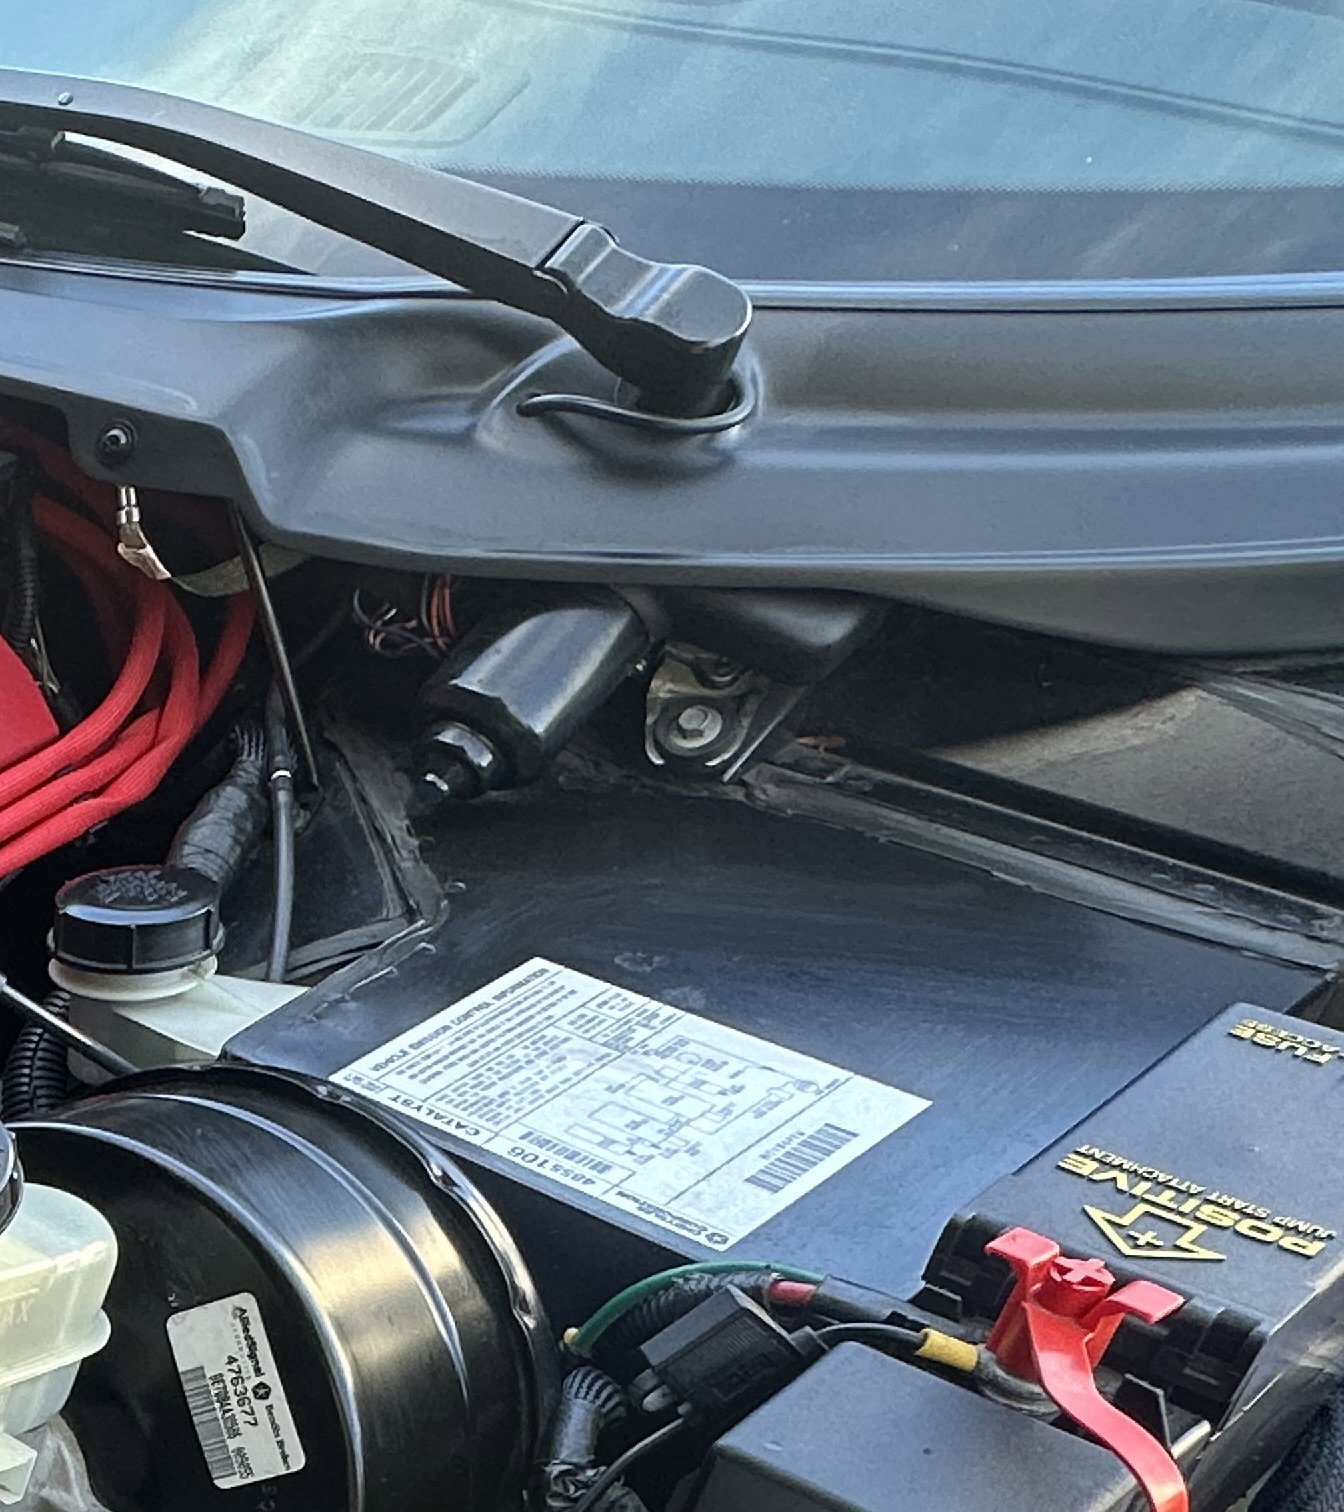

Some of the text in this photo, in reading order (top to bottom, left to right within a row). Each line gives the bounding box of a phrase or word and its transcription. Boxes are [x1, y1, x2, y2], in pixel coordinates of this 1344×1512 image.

[1227, 1023, 1331, 1066] FUSE
[387, 1093, 483, 1137] CATALYST
[1056, 1151, 1326, 1259] POSITIVE
[1075, 1144, 1339, 1239] JUMP START ATTACHMENT
[222, 1353, 259, 1429] 4763677
